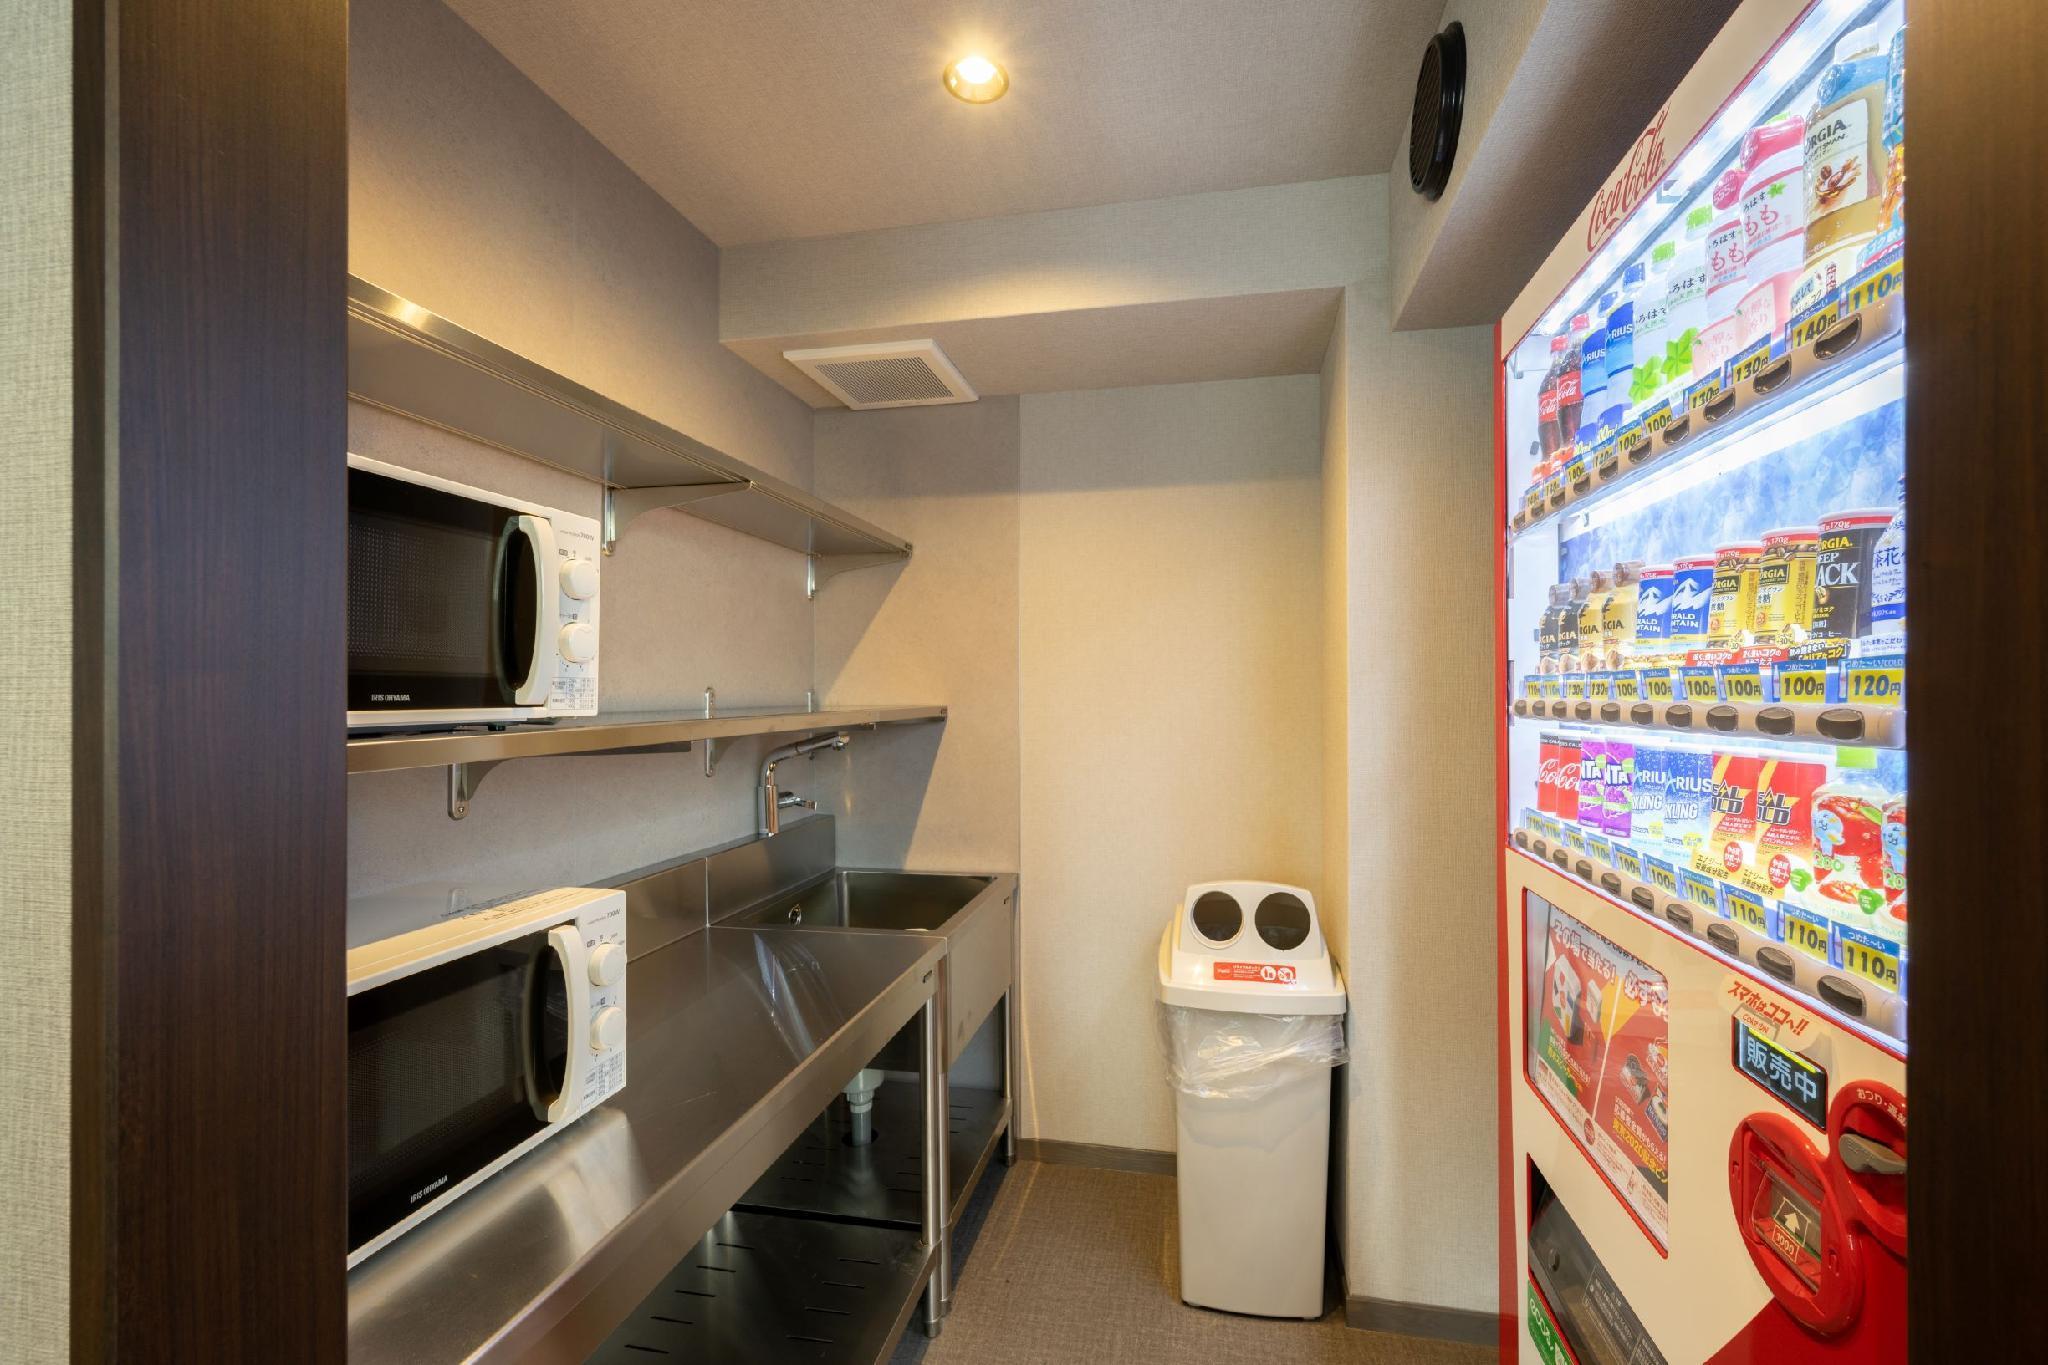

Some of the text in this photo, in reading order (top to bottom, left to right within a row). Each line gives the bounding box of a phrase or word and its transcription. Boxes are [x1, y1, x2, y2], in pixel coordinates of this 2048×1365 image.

[1687, 680, 1718, 697] 100円
[1727, 679, 1761, 697] 100円
[1784, 676, 1825, 696] 100円
[1854, 674, 1903, 697] 120円
[1731, 900, 1767, 929] 110円
[1788, 921, 1827, 954] 110円
[1847, 945, 1898, 985] 110円
[1747, 1036, 1817, 1103] 販売中
